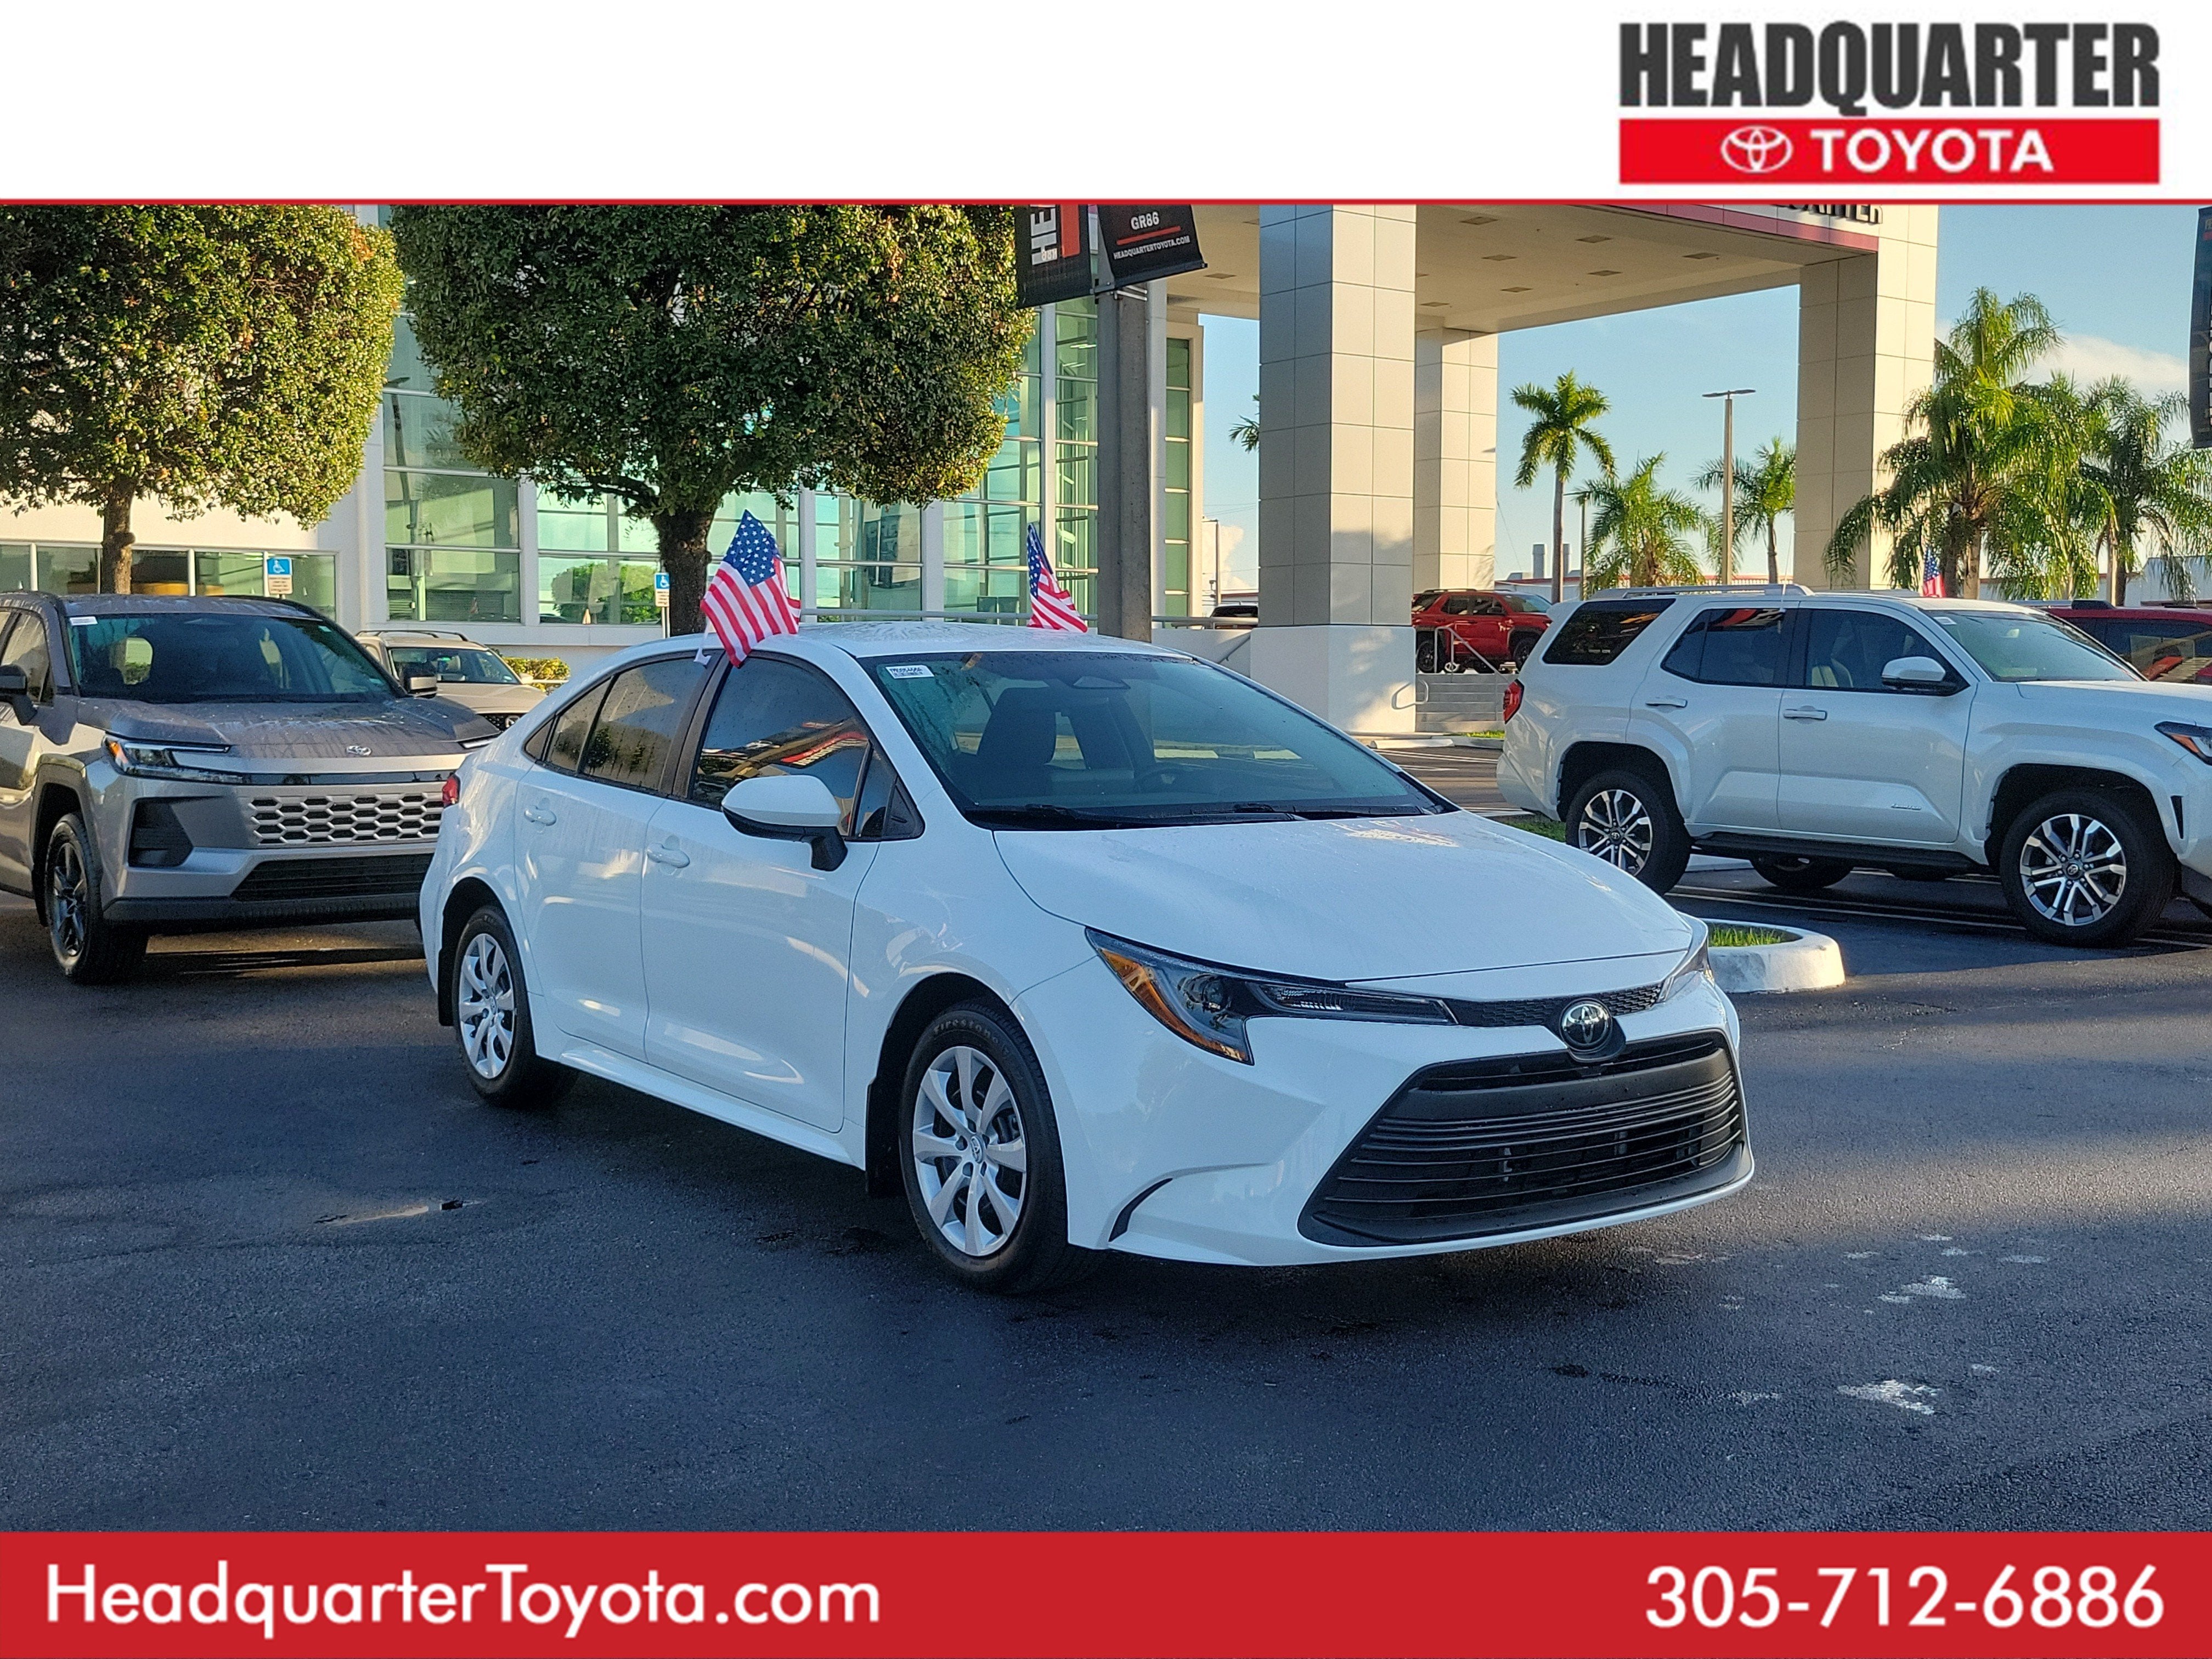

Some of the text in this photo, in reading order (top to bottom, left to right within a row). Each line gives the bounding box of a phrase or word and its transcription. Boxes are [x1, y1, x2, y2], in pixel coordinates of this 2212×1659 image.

[1131, 211, 1160, 230] GR86
[1030, 205, 1058, 266] HE
[1113, 235, 1190, 260] HEADQUARTERTOYOTA.COM
